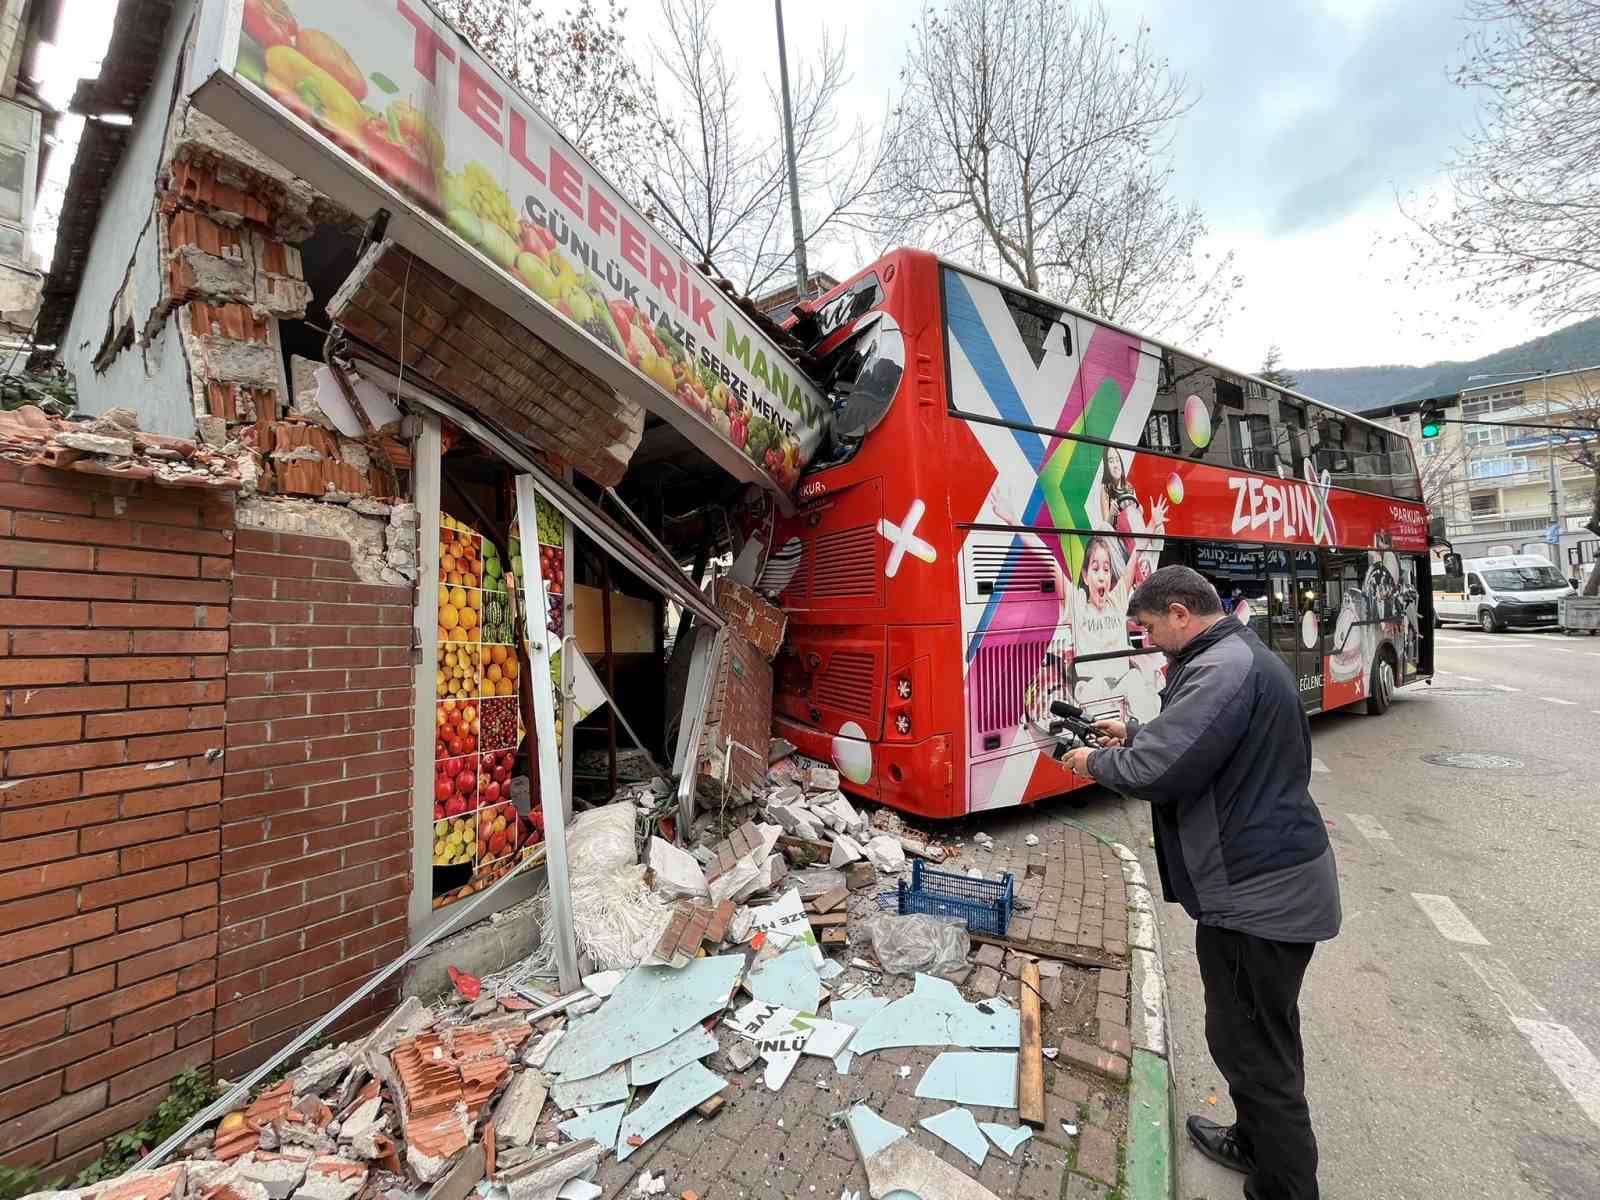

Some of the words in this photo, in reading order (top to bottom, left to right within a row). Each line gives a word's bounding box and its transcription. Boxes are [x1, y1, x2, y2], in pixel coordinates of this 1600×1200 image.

[396, 0, 717, 341] TELEFERİK
[524, 195, 640, 308] GÜNLÜK
[646, 296, 697, 357] TAZE
[700, 345, 750, 401] SEBZE
[751, 394, 794, 436] MEYVE
